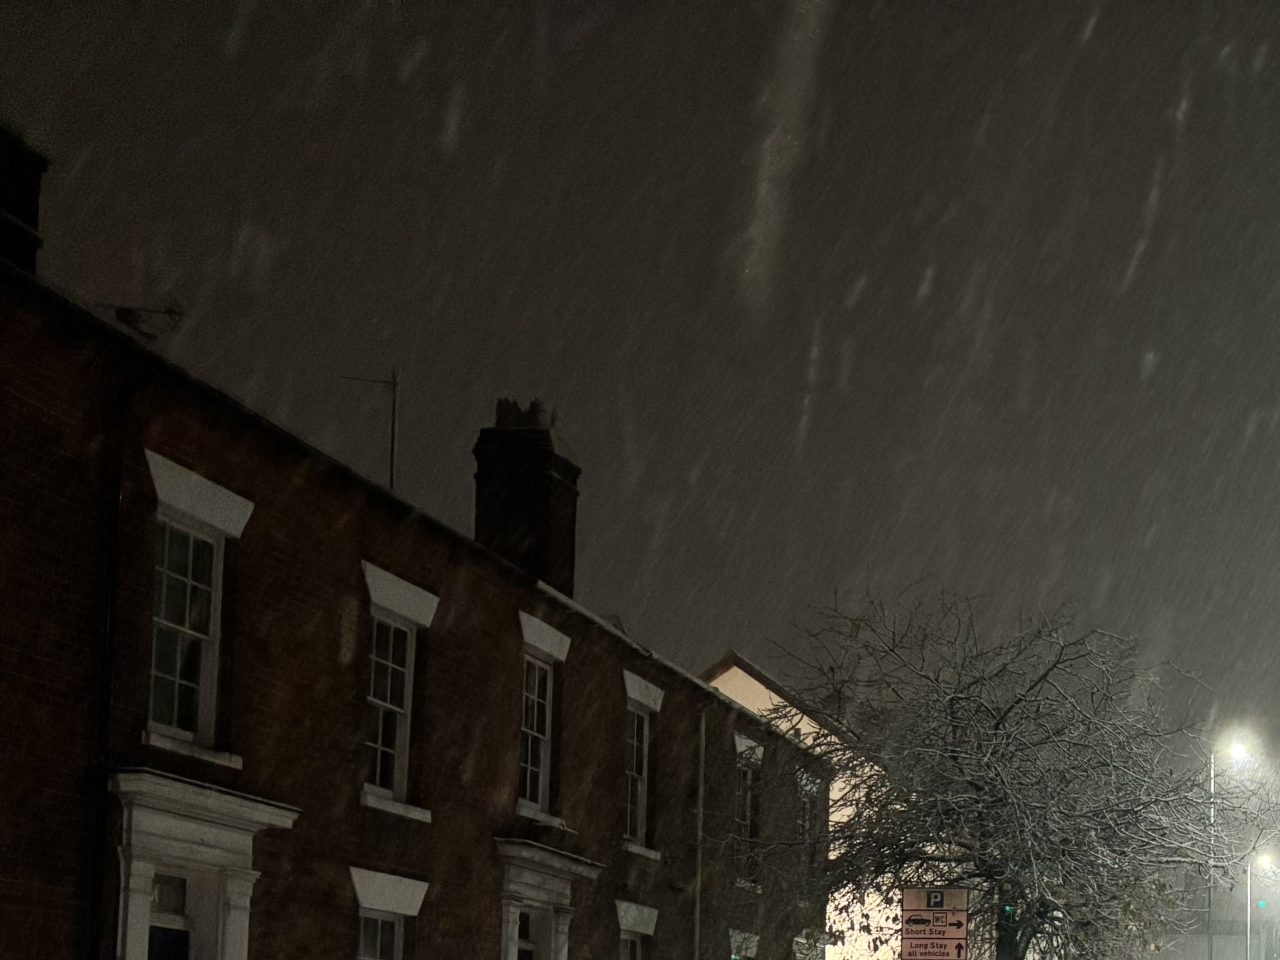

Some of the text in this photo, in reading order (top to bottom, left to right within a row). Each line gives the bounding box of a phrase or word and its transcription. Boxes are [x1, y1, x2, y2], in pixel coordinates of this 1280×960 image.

[930, 892, 942, 907] P
[934, 915, 945, 924] WC
[928, 928, 946, 936] Stay
[910, 942, 948, 950] Long Stay
